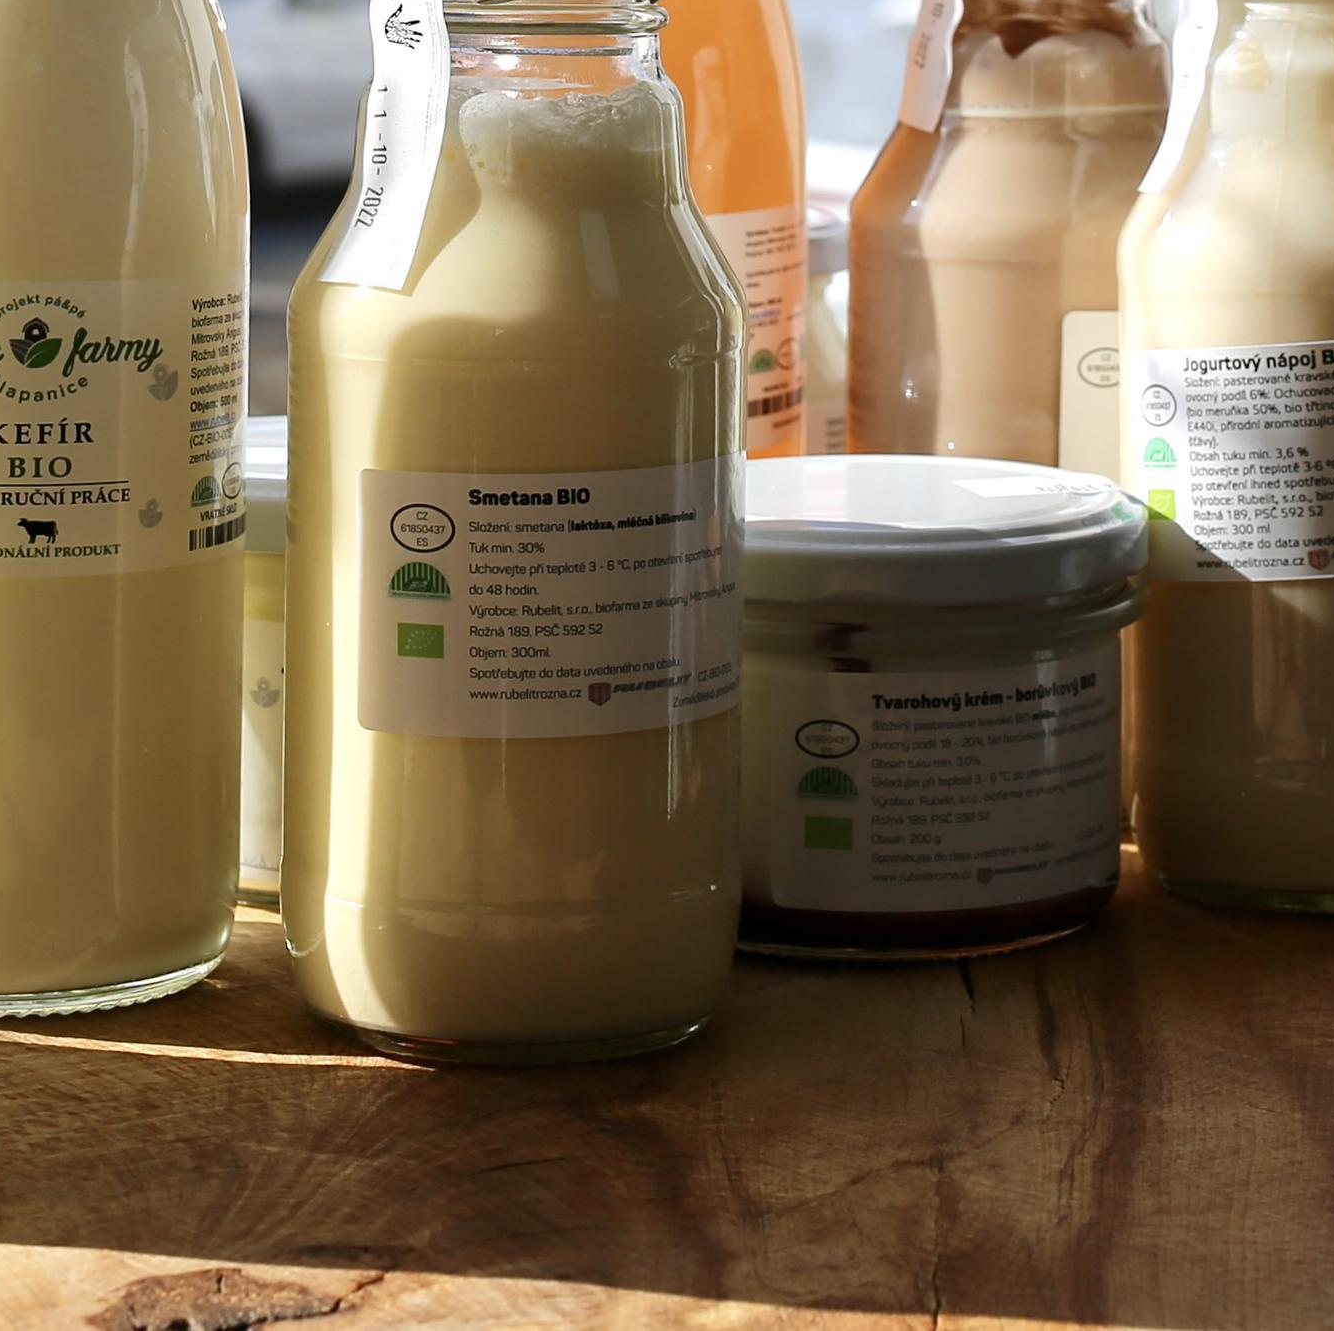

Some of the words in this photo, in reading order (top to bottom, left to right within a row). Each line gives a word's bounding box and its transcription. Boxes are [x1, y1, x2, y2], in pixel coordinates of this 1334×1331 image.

[354, 186, 384, 228] 2022
[62, 327, 163, 378] farmy
[1183, 353, 1261, 375] Jogurtový
[1266, 350, 1316, 371] nápoj
[1223, 373, 1291, 388] pasterované
[1185, 390, 1218, 404] ovocný
[1284, 403, 1302, 413] bio
[1189, 450, 1219, 462] Obsah
[1222, 450, 1246, 461] tuku
[1275, 447, 1294, 460] 3,6
[1296, 446, 1309, 458] %
[7, 456, 73, 478] BIO
[1190, 465, 1239, 478] Uchovejte
[1242, 464, 1257, 476] při
[1191, 482, 1203, 492] po
[1206, 480, 1247, 491] otevření
[1251, 478, 1280, 489] ihned
[1, 487, 65, 506] RUČNÍ
[70, 486, 131, 505] PRÁCE
[468, 489, 553, 506] Smetana
[557, 488, 590, 505] BIO
[416, 511, 428, 521] CZ
[1193, 508, 1223, 521] Rožná
[1254, 505, 1278, 519] PSČ
[1281, 506, 1305, 518] 592
[1308, 505, 1324, 517] 52
[468, 520, 511, 533] Složení:
[516, 521, 565, 533] smetana
[1231, 523, 1253, 535] 300
[1256, 523, 1270, 534] ml
[417, 537, 429, 547] ES
[468, 541, 490, 554] Tuk
[517, 542, 545, 554] 30%
[1257, 538, 1271, 549] do
[1274, 537, 1300, 548] data
[57, 543, 121, 558] PRODUKT
[468, 562, 526, 578] Uchovejte
[529, 563, 544, 579] při
[588, 561, 597, 573] 3
[607, 559, 615, 572] 6
[633, 559, 646, 573] po
[468, 584, 483, 596] do
[485, 584, 503, 596] 48
[468, 604, 519, 619] Výrobce:
[595, 600, 640, 615] biofarma
[469, 624, 505, 637] Rožná
[535, 623, 559, 637] PSČ
[562, 624, 586, 636] 592
[588, 623, 604, 635] 52
[469, 646, 507, 661] Objem:
[469, 667, 536, 681] Spotřebujte
[539, 667, 553, 678] do
[556, 667, 580, 678] data
[584, 662, 641, 676] uvedeného
[468, 688, 582, 701] www.rubelitrozna.cz
[871, 691, 962, 712] Tvarohový
[964, 690, 1004, 707] krém
[1080, 672, 1097, 691] BIO
[909, 832, 932, 844] 200
